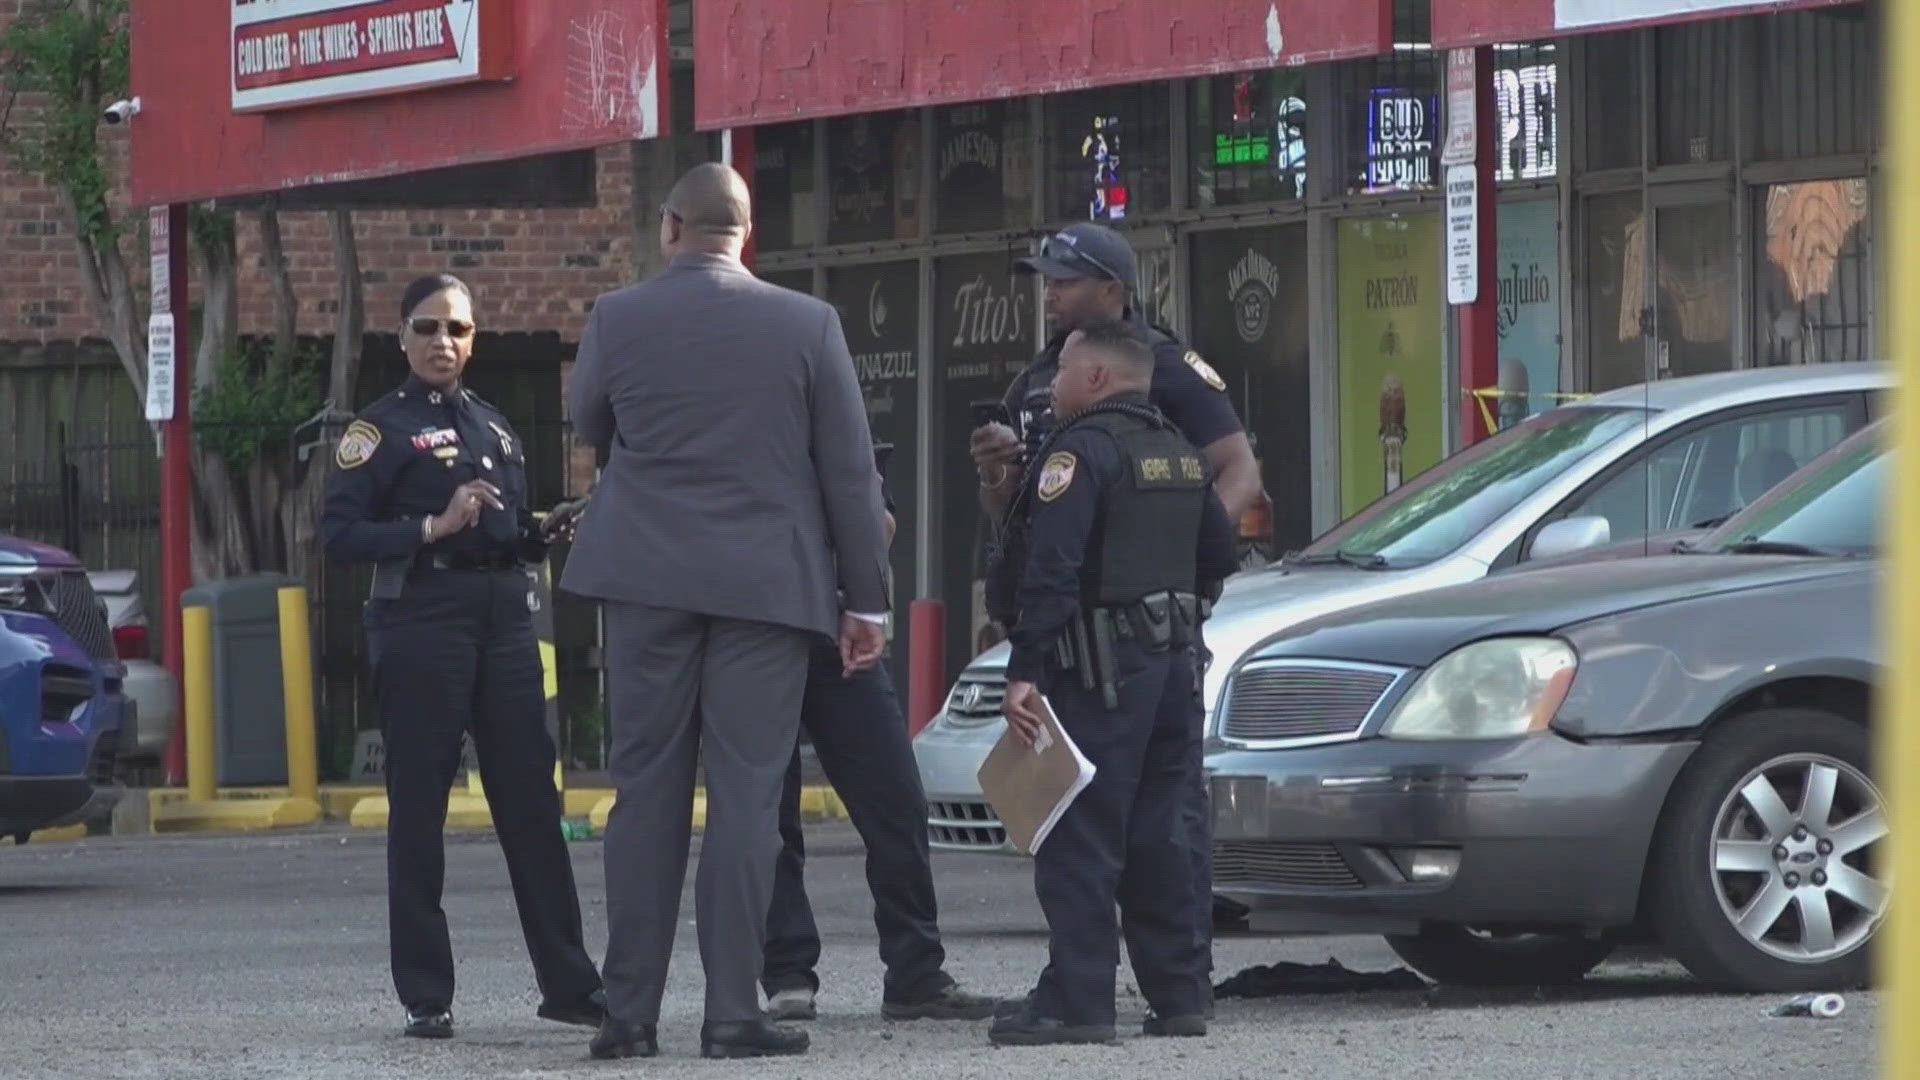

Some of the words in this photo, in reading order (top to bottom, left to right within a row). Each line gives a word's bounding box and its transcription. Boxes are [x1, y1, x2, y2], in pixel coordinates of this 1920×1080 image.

[238, 34, 264, 76] COLD
[265, 31, 291, 71] BEER
[298, 26, 322, 66] FINE
[323, 20, 359, 62] WINES
[367, 12, 413, 56] SPIRITS
[414, 7, 445, 49] HERE
[1380, 98, 1424, 141] BUD
[939, 131, 998, 180] JAMESON
[1228, 256, 1248, 302] JACK
[1366, 270, 1418, 309] PATRÓN
[953, 273, 1025, 348] Tito's
